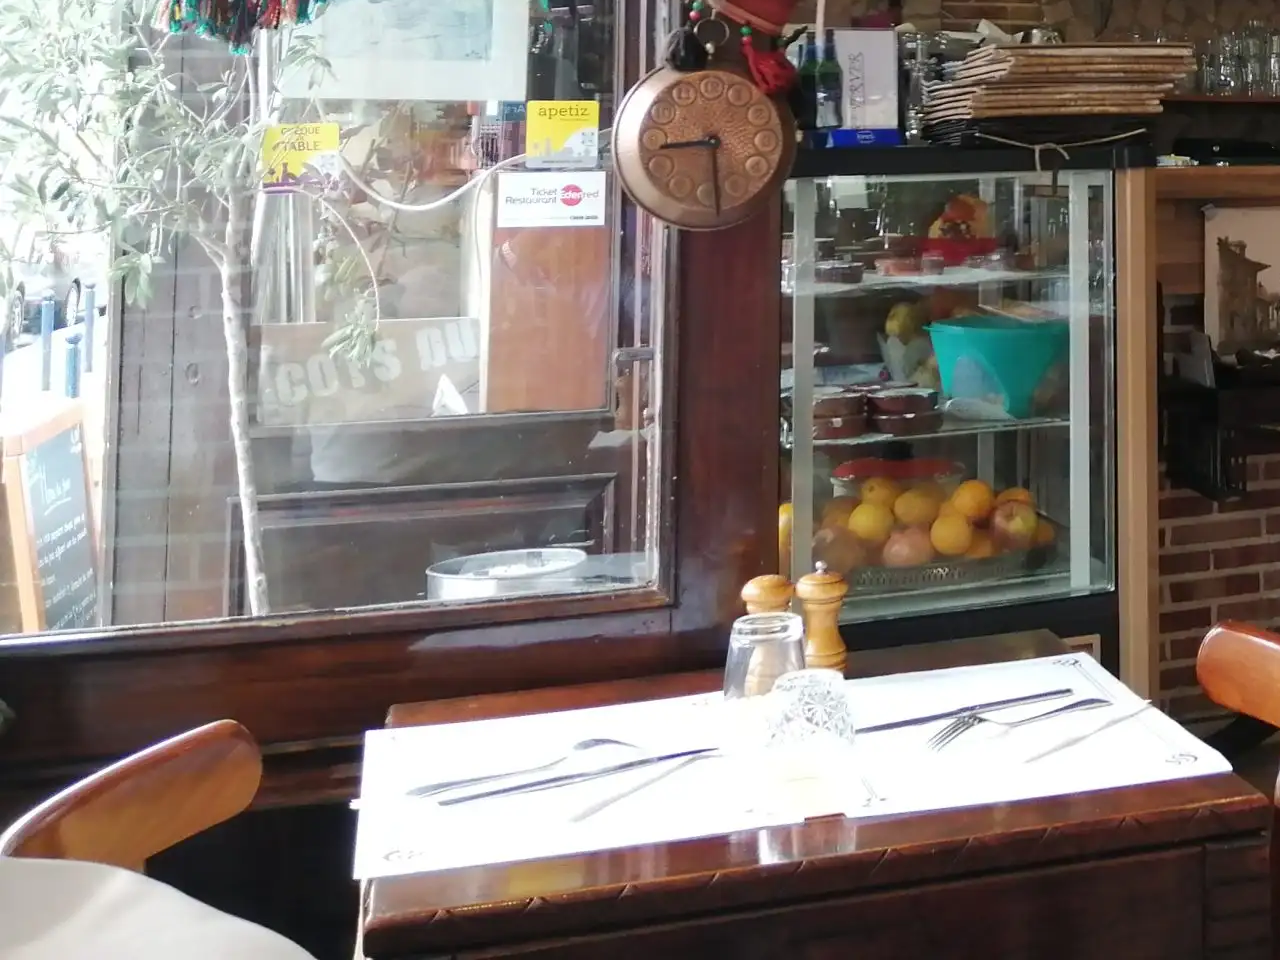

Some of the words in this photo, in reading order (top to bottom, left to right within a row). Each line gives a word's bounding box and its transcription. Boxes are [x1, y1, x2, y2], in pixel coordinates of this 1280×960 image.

[538, 103, 590, 120] apetiz
[530, 187, 558, 196] Ticket
[505, 196, 558, 205] Restaurant
